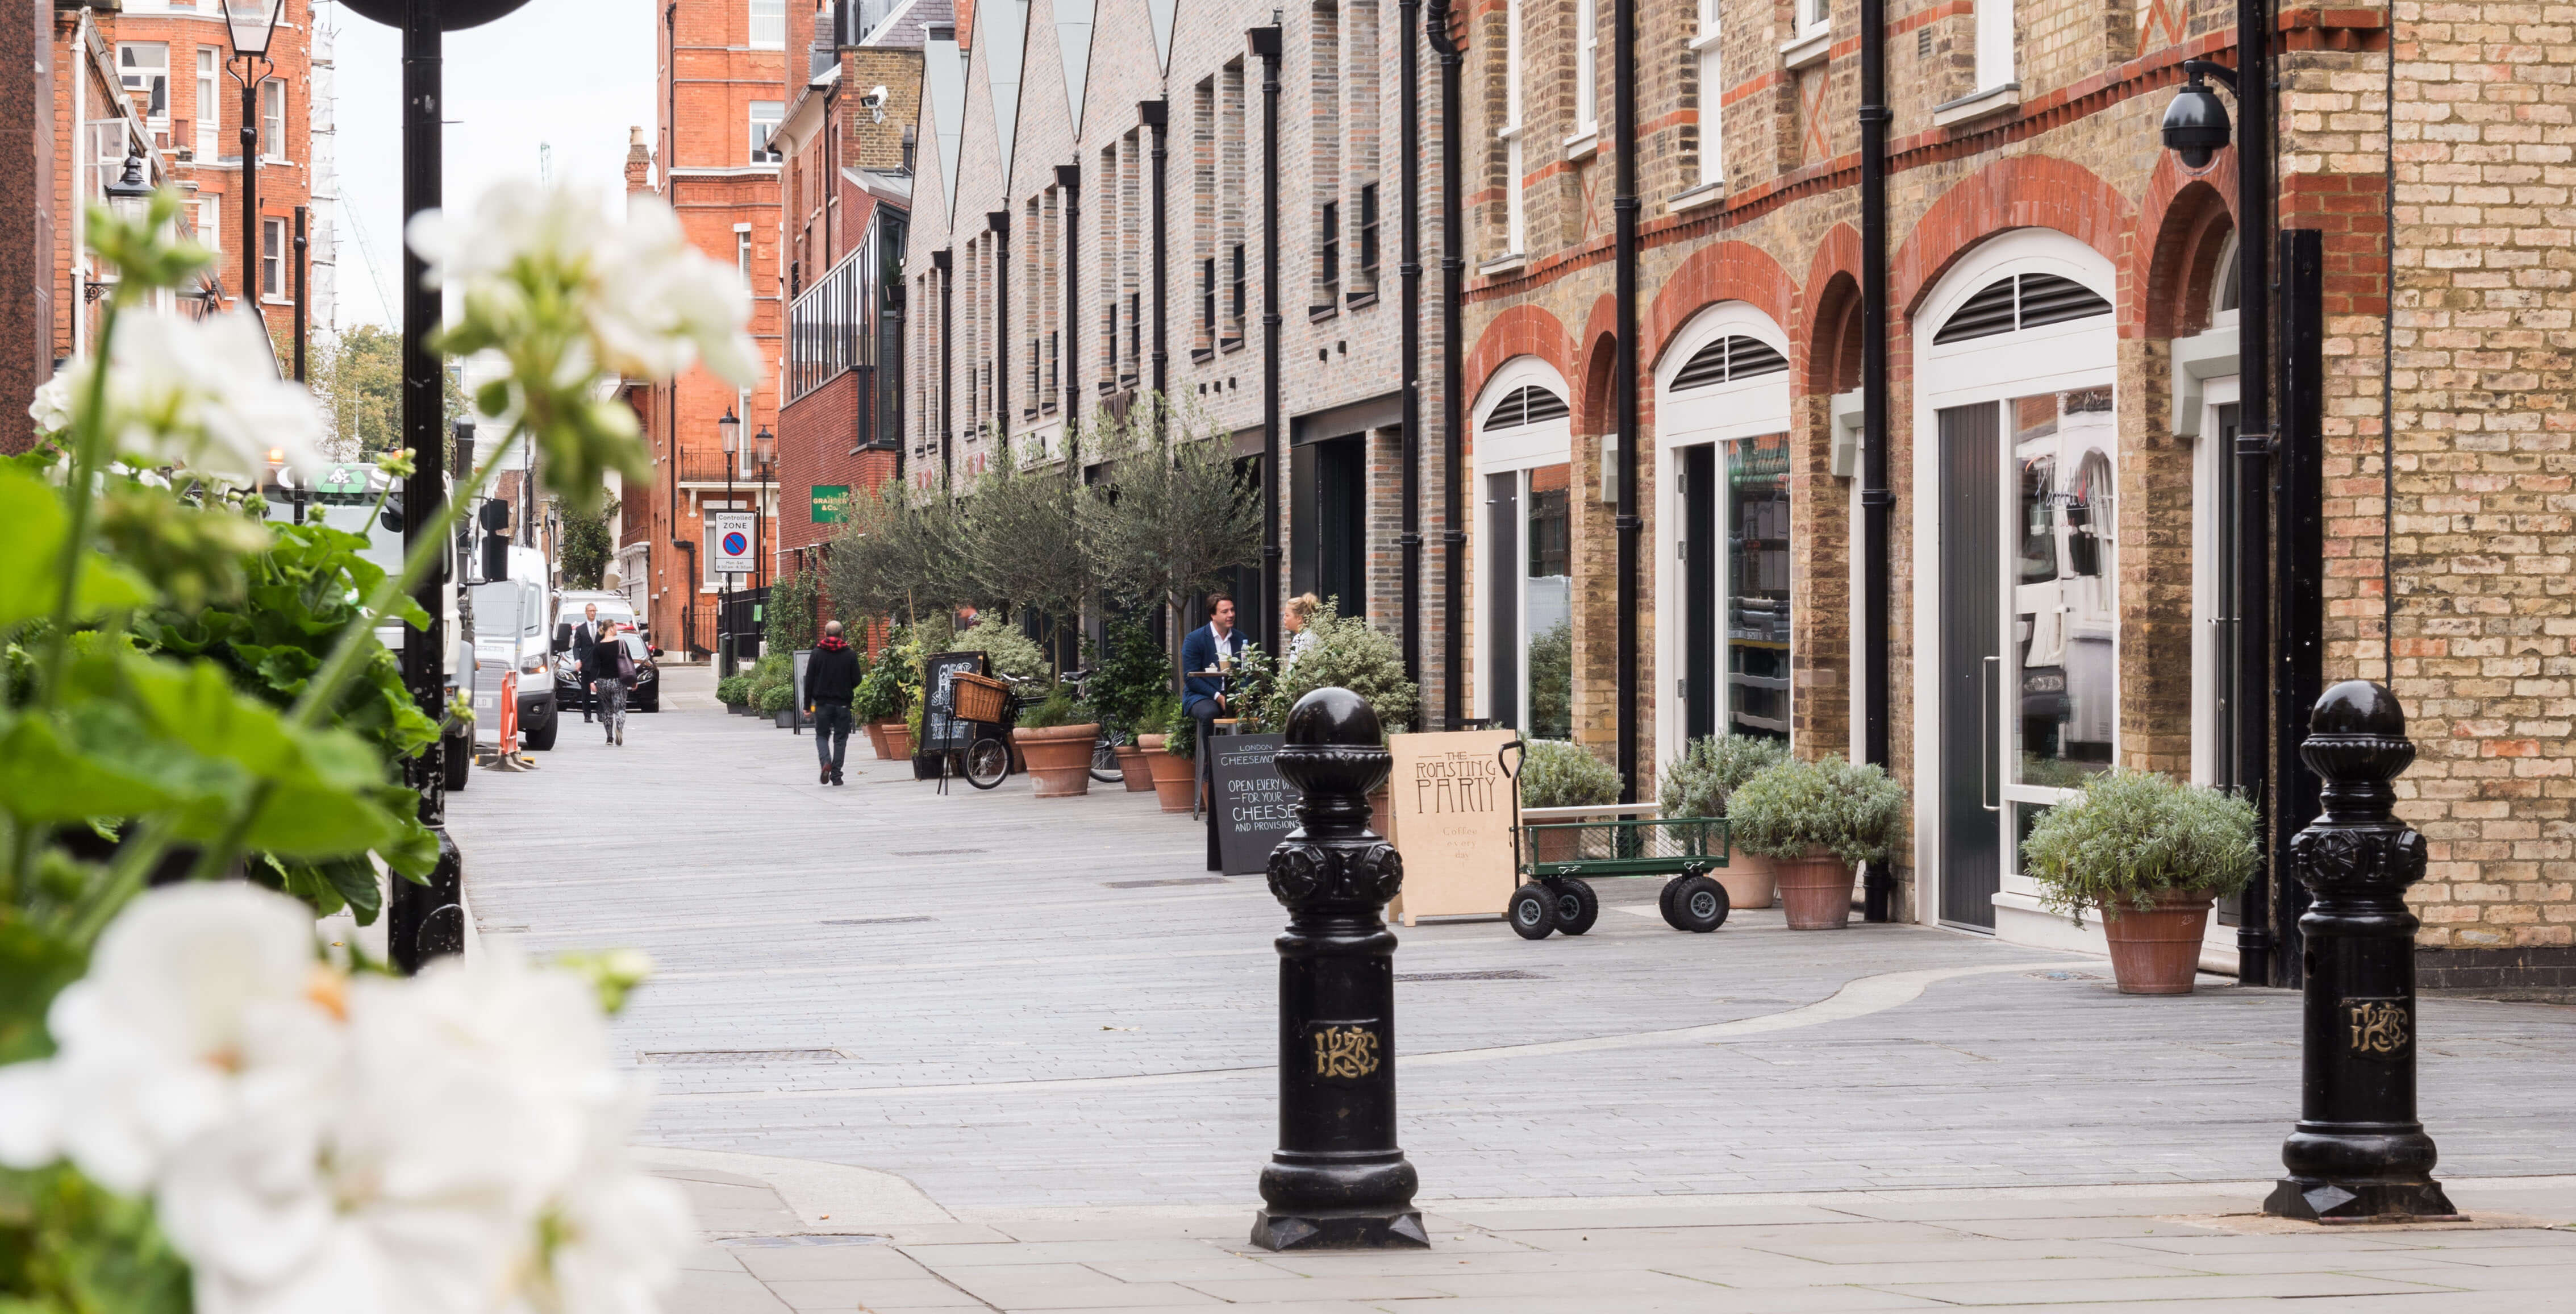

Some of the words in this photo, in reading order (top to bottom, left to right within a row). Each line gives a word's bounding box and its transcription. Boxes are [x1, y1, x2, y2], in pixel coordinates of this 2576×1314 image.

[330, 468, 349, 483] &
[1220, 755, 1274, 766] CHEESEMO
[1416, 760, 1496, 778] ROASTING
[1228, 779, 1254, 792] OPEN
[1257, 778, 1279, 791] EVERY
[1241, 793, 1260, 803] FOR
[1262, 791, 1284, 802] YOUR
[1415, 777, 1496, 814] PARTY
[1232, 803, 1297, 821] CHEESE
[1235, 823, 1251, 832] AND
[1254, 819, 1300, 831] PROVISIONS
[1443, 827, 1477, 836] Coffee
[1447, 841, 1476, 849] every
